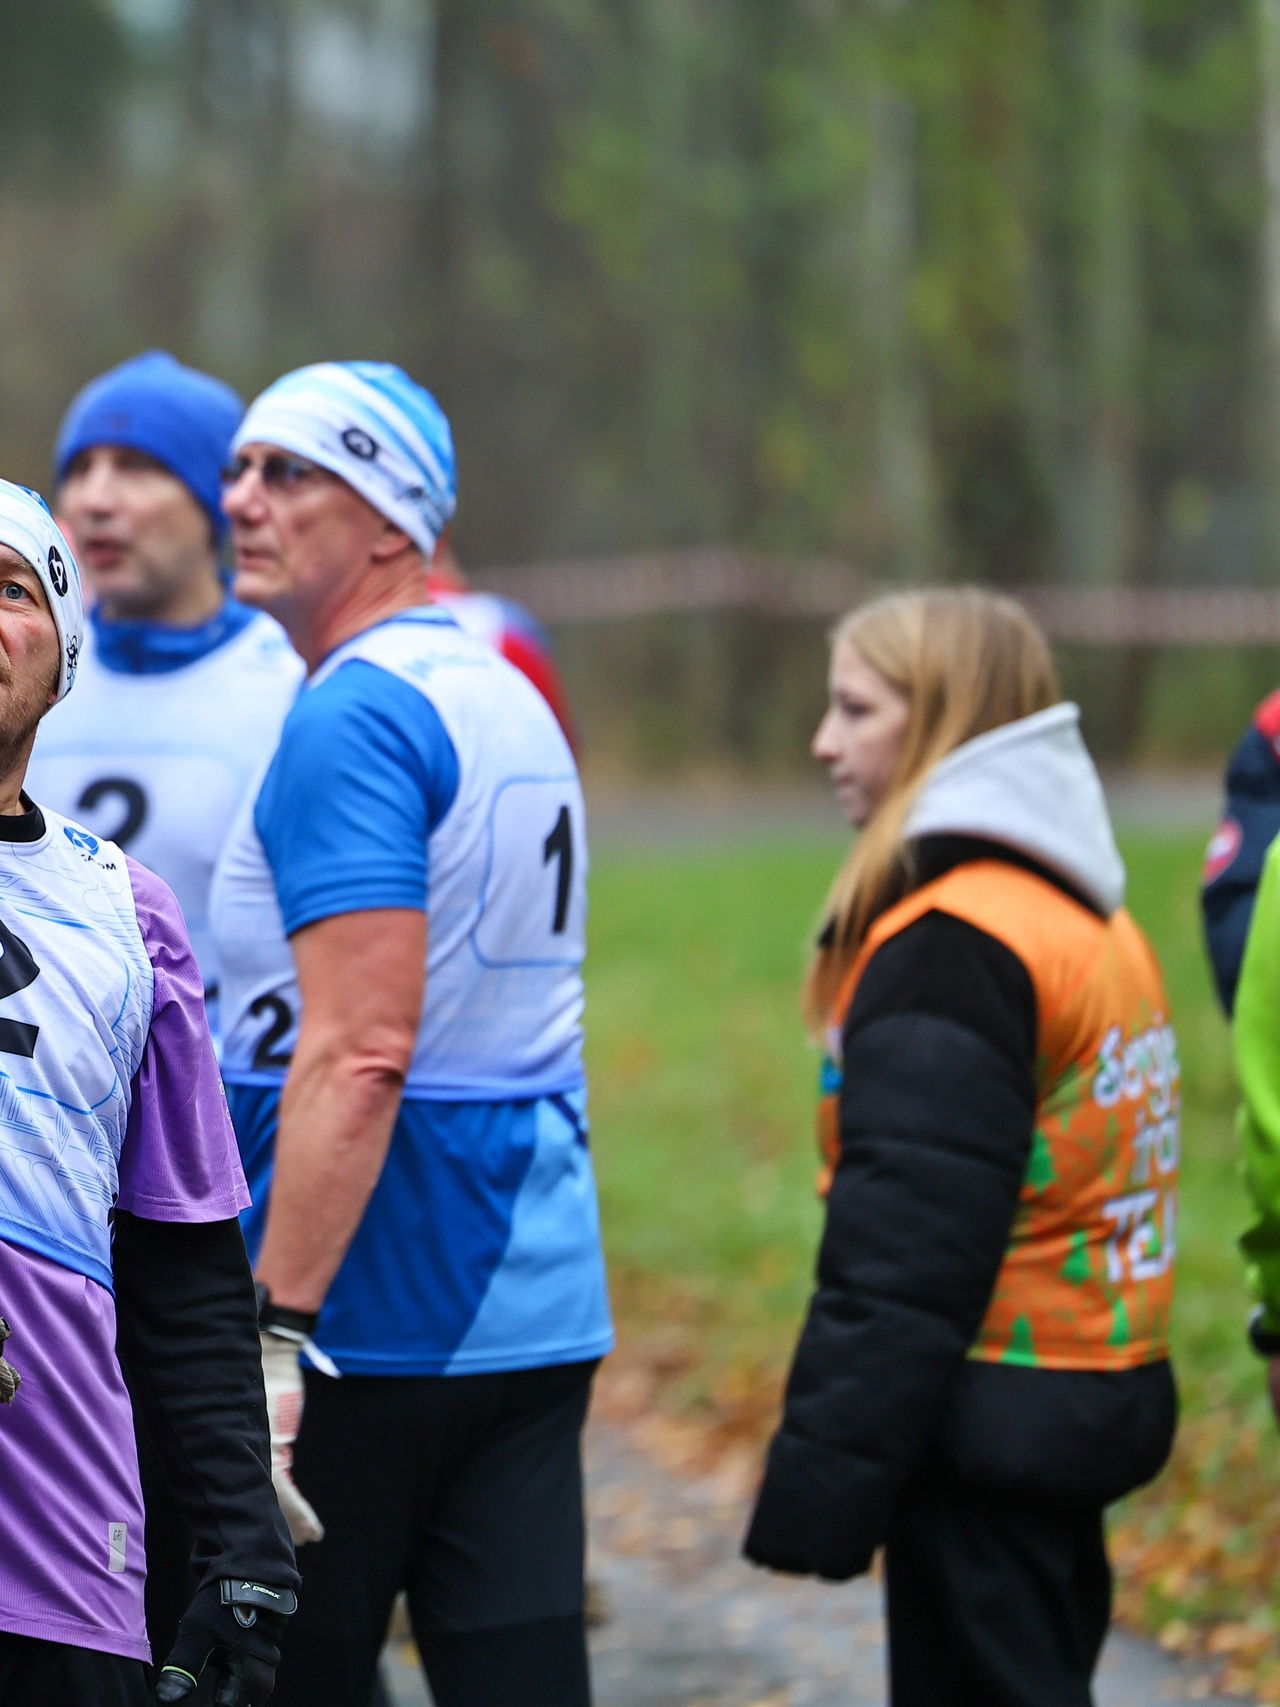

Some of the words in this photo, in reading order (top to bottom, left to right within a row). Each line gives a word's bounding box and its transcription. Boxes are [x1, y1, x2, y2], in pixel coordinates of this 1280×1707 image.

[542, 804, 573, 934] 1
[246, 993, 294, 1072] 2
[252, 1585, 281, 1599] DEMIX
